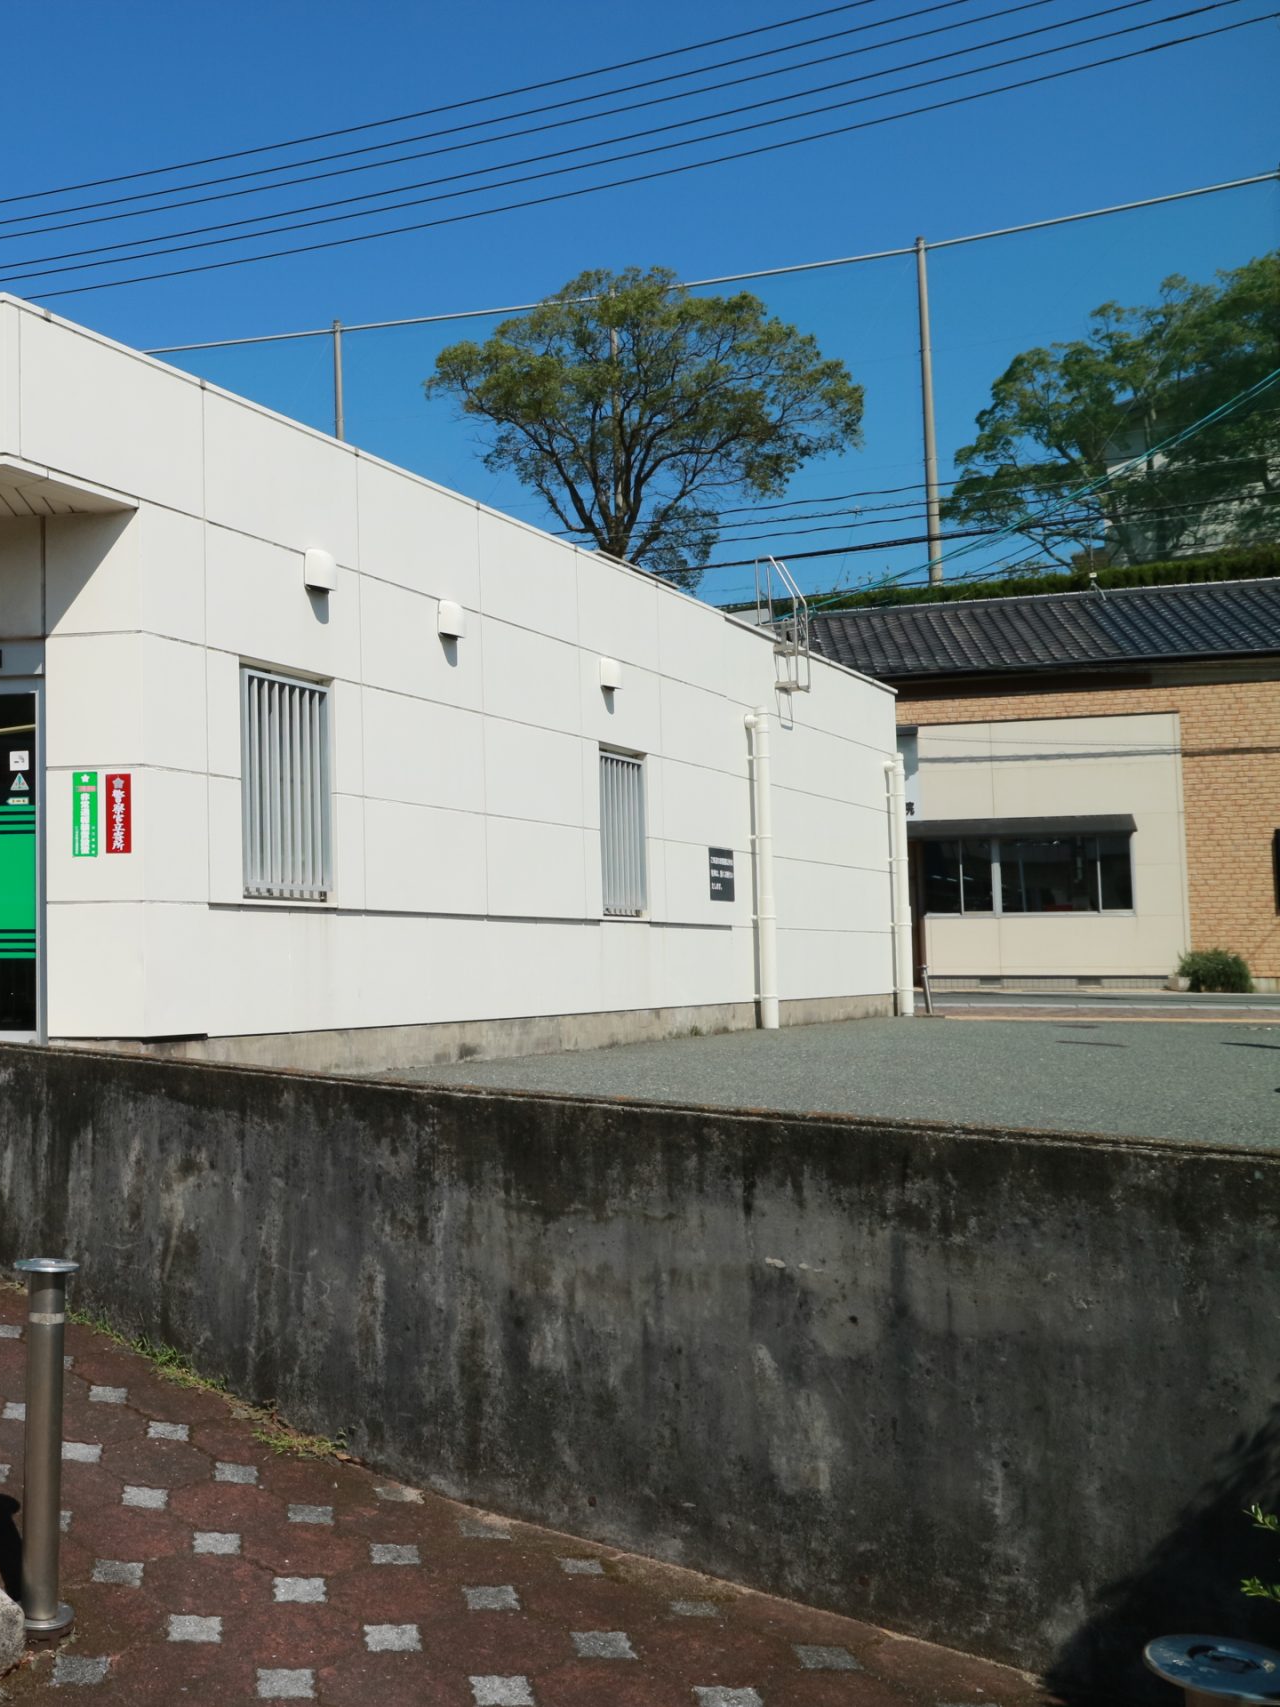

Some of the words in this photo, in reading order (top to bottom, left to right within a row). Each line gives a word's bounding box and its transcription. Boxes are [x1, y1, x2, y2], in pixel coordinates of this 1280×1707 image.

[112, 788, 126, 852] 警察官立寄所
